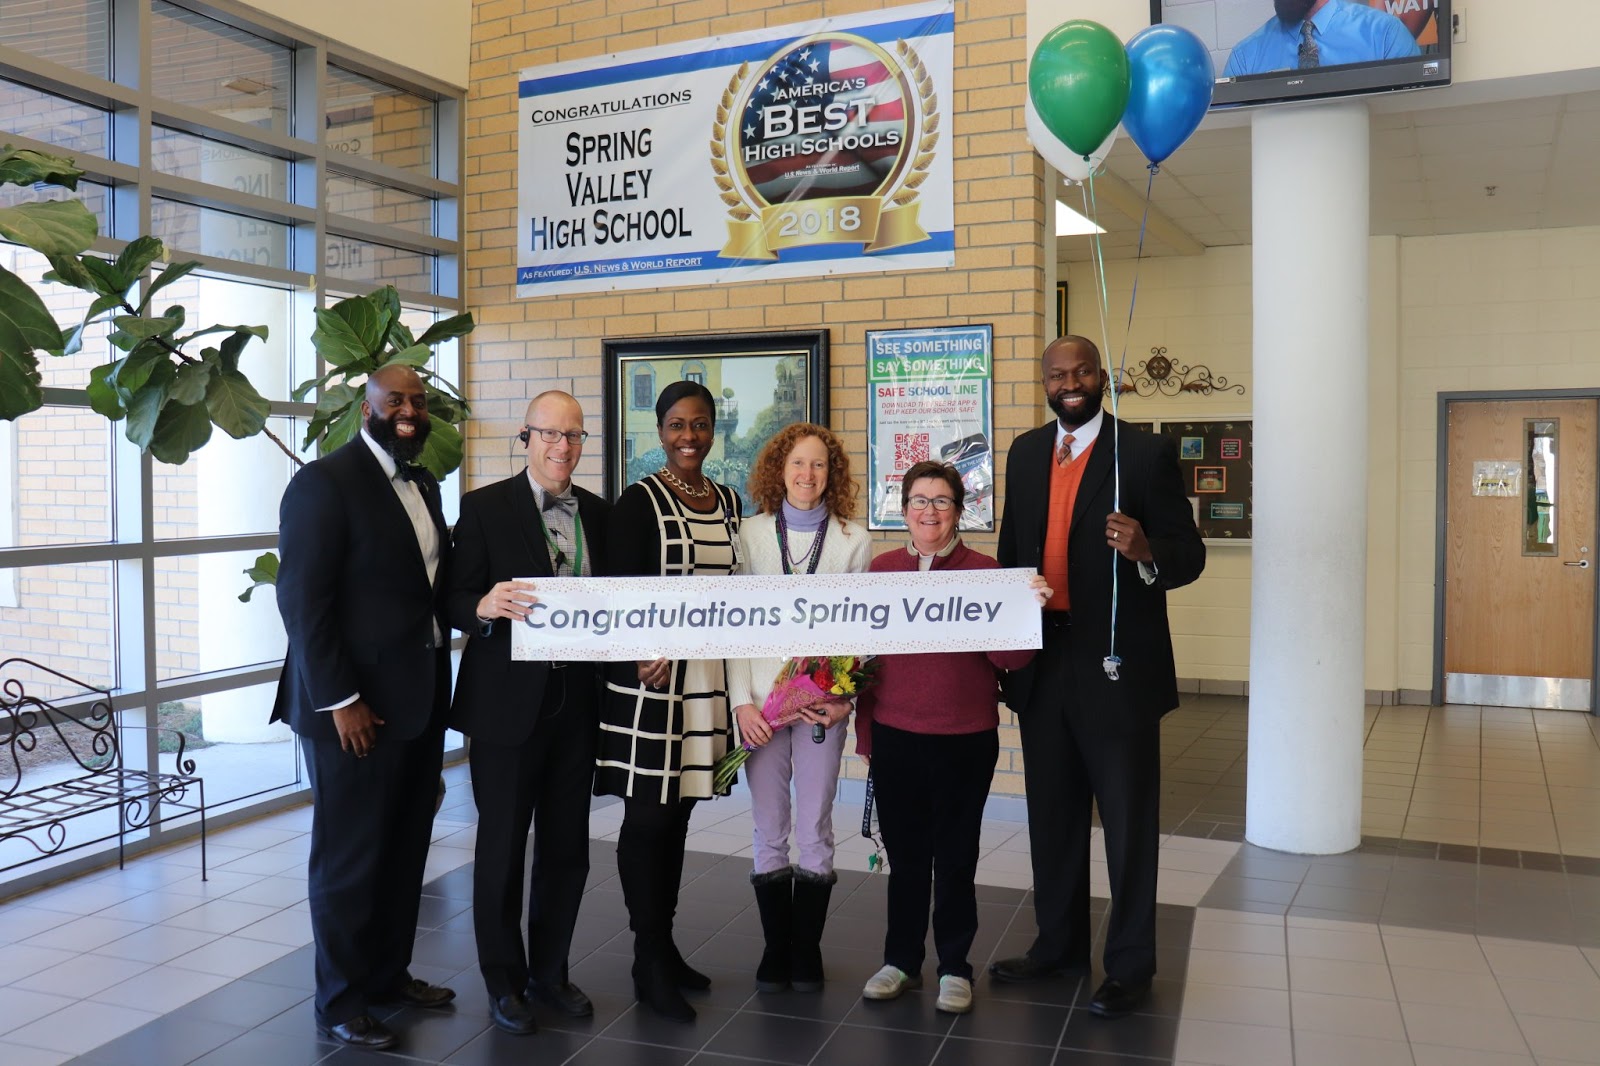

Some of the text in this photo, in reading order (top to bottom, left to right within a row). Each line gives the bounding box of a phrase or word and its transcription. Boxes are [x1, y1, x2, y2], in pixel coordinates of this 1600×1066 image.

[776, 77, 866, 100] AMERICA'S
[531, 89, 692, 124] CONGRATULATIONS
[762, 97, 875, 139] BEST
[566, 128, 652, 167] SPRING
[745, 130, 900, 162] HIGH SCHOOLS
[796, 169, 812, 177] News
[819, 166, 838, 174] World
[839, 164, 860, 172] Report
[565, 169, 653, 207] VALLEY
[531, 208, 692, 251] HIGH SCHOOL
[778, 206, 861, 237] 2018
[533, 269, 573, 278] FEATURED:
[574, 265, 592, 274] U.S.
[594, 264, 620, 273] NEWS
[621, 263, 629, 271] &
[631, 260, 664, 270] WORLD
[665, 257, 702, 267] REPORT
[876, 339, 982, 355] SEE SOMETHING
[876, 357, 982, 373] SAY SOMETHING
[878, 384, 978, 397] SAFE SCHOOL LINE
[524, 596, 1003, 635] Congratulations Spring Valley
